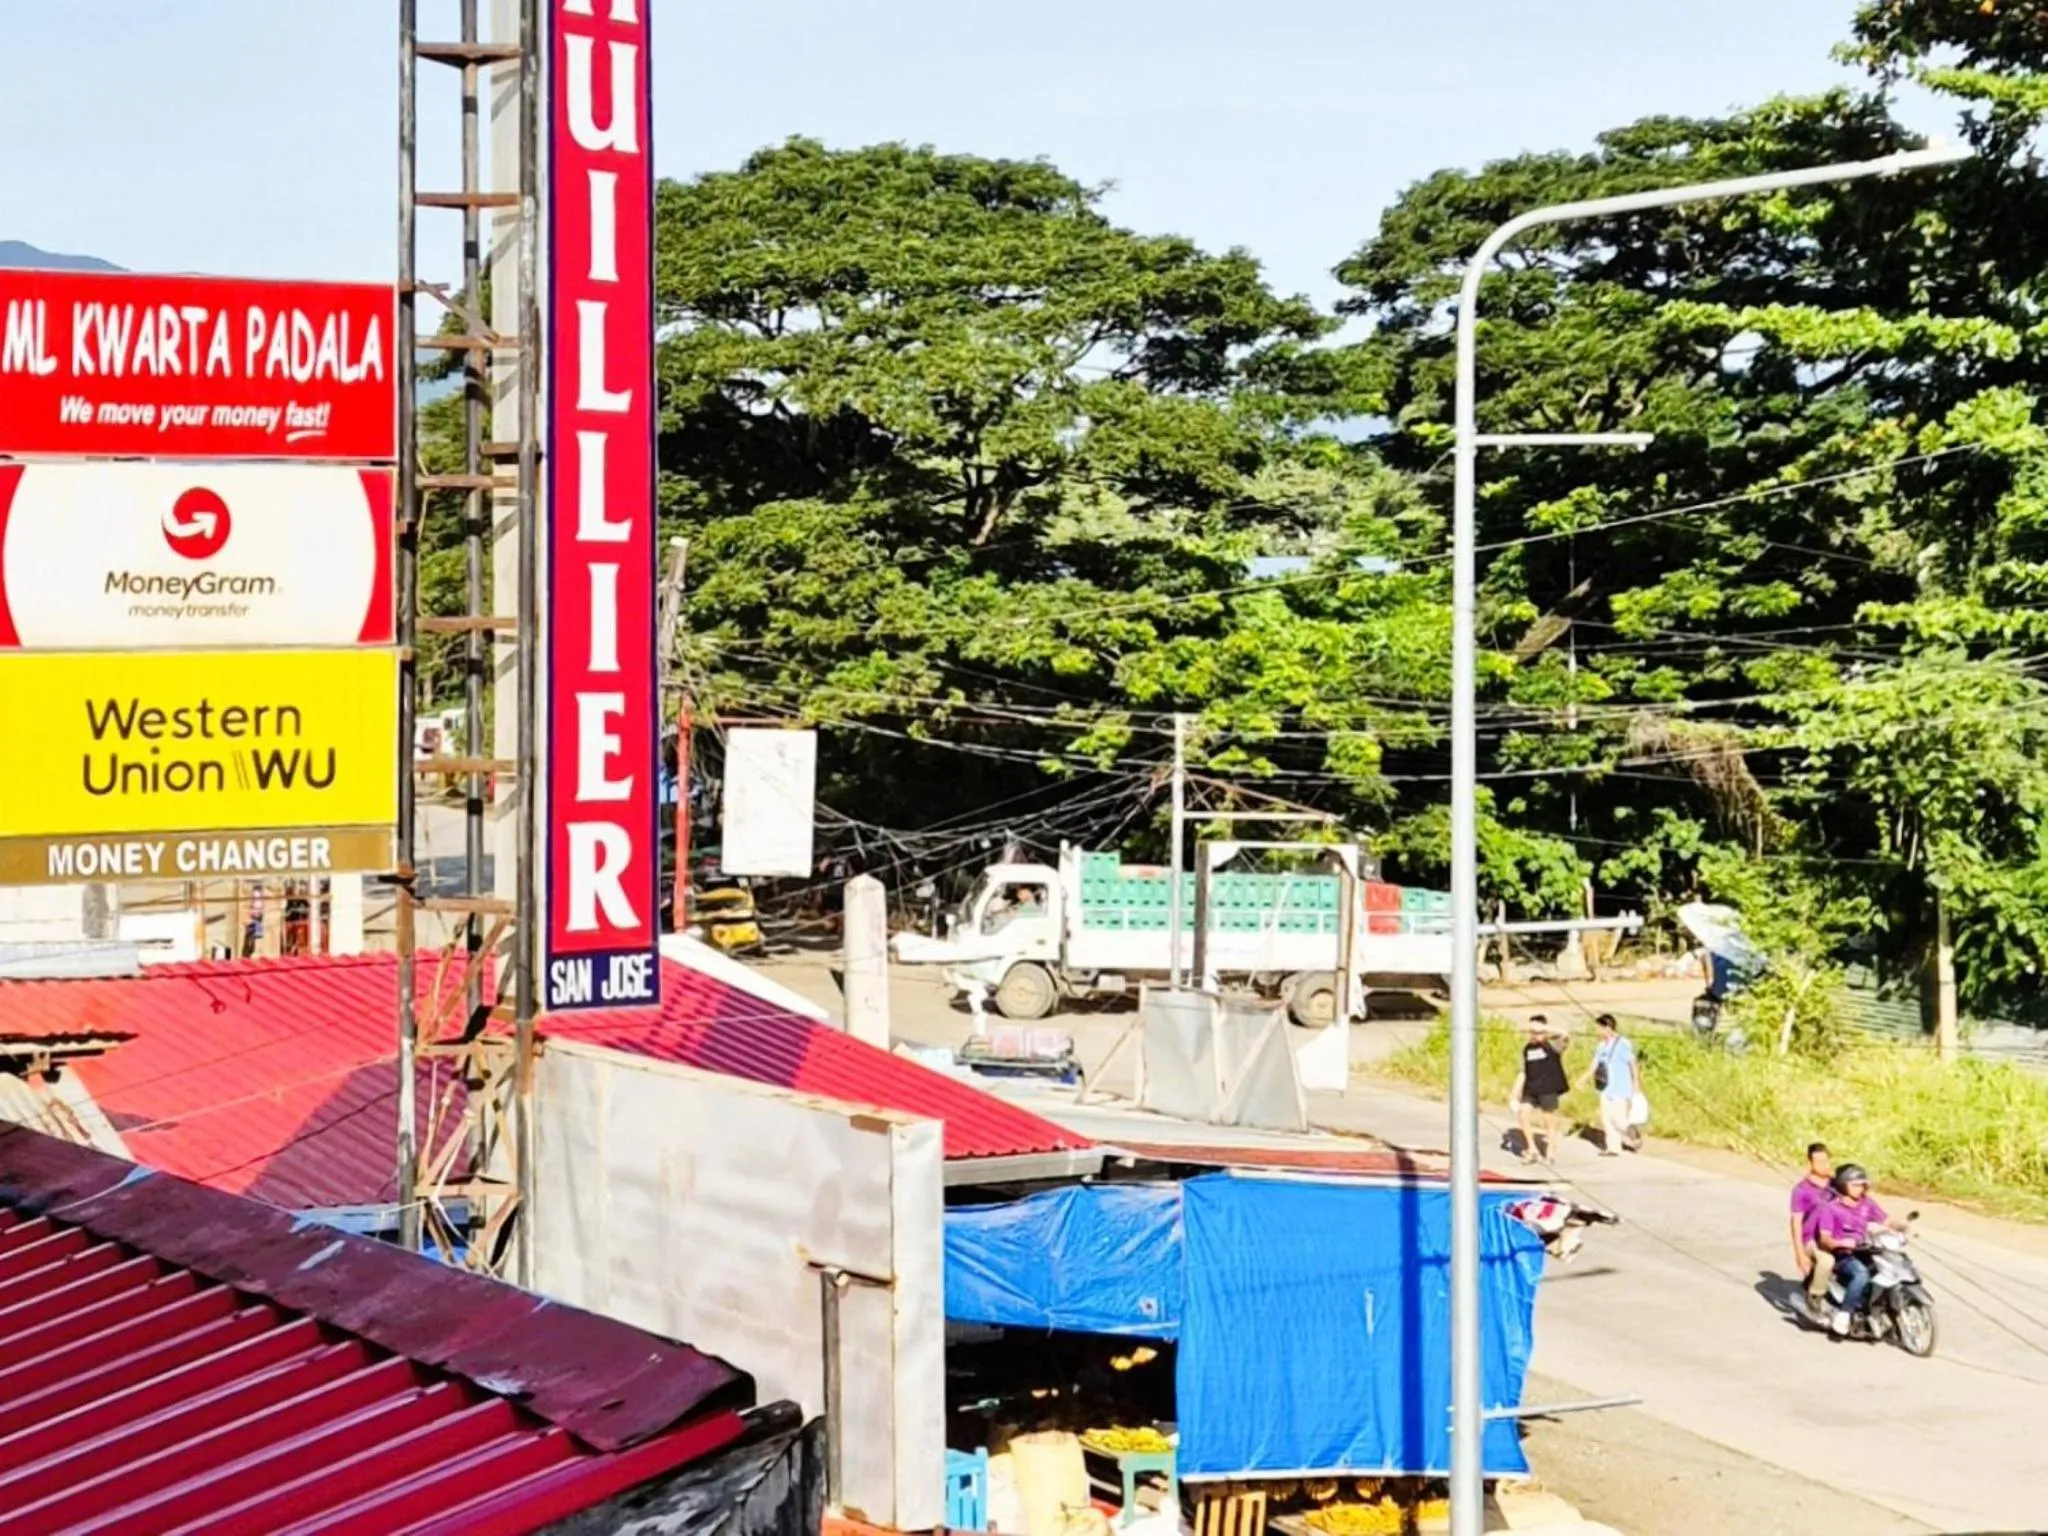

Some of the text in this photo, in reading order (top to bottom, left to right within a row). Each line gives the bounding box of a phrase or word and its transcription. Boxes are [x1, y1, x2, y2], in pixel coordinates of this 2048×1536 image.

[2, 299, 384, 384] ML KWARTA PADALA
[60, 396, 331, 433] We move your money fast!
[562, 0, 642, 933] UILLIER
[104, 570, 275, 600] MoneyGram
[128, 601, 250, 620] money transfer
[85, 698, 301, 741] Western
[82, 746, 225, 796] Union
[48, 836, 331, 876] MONEY CHANGER
[550, 952, 653, 1005] SAN JOSE
